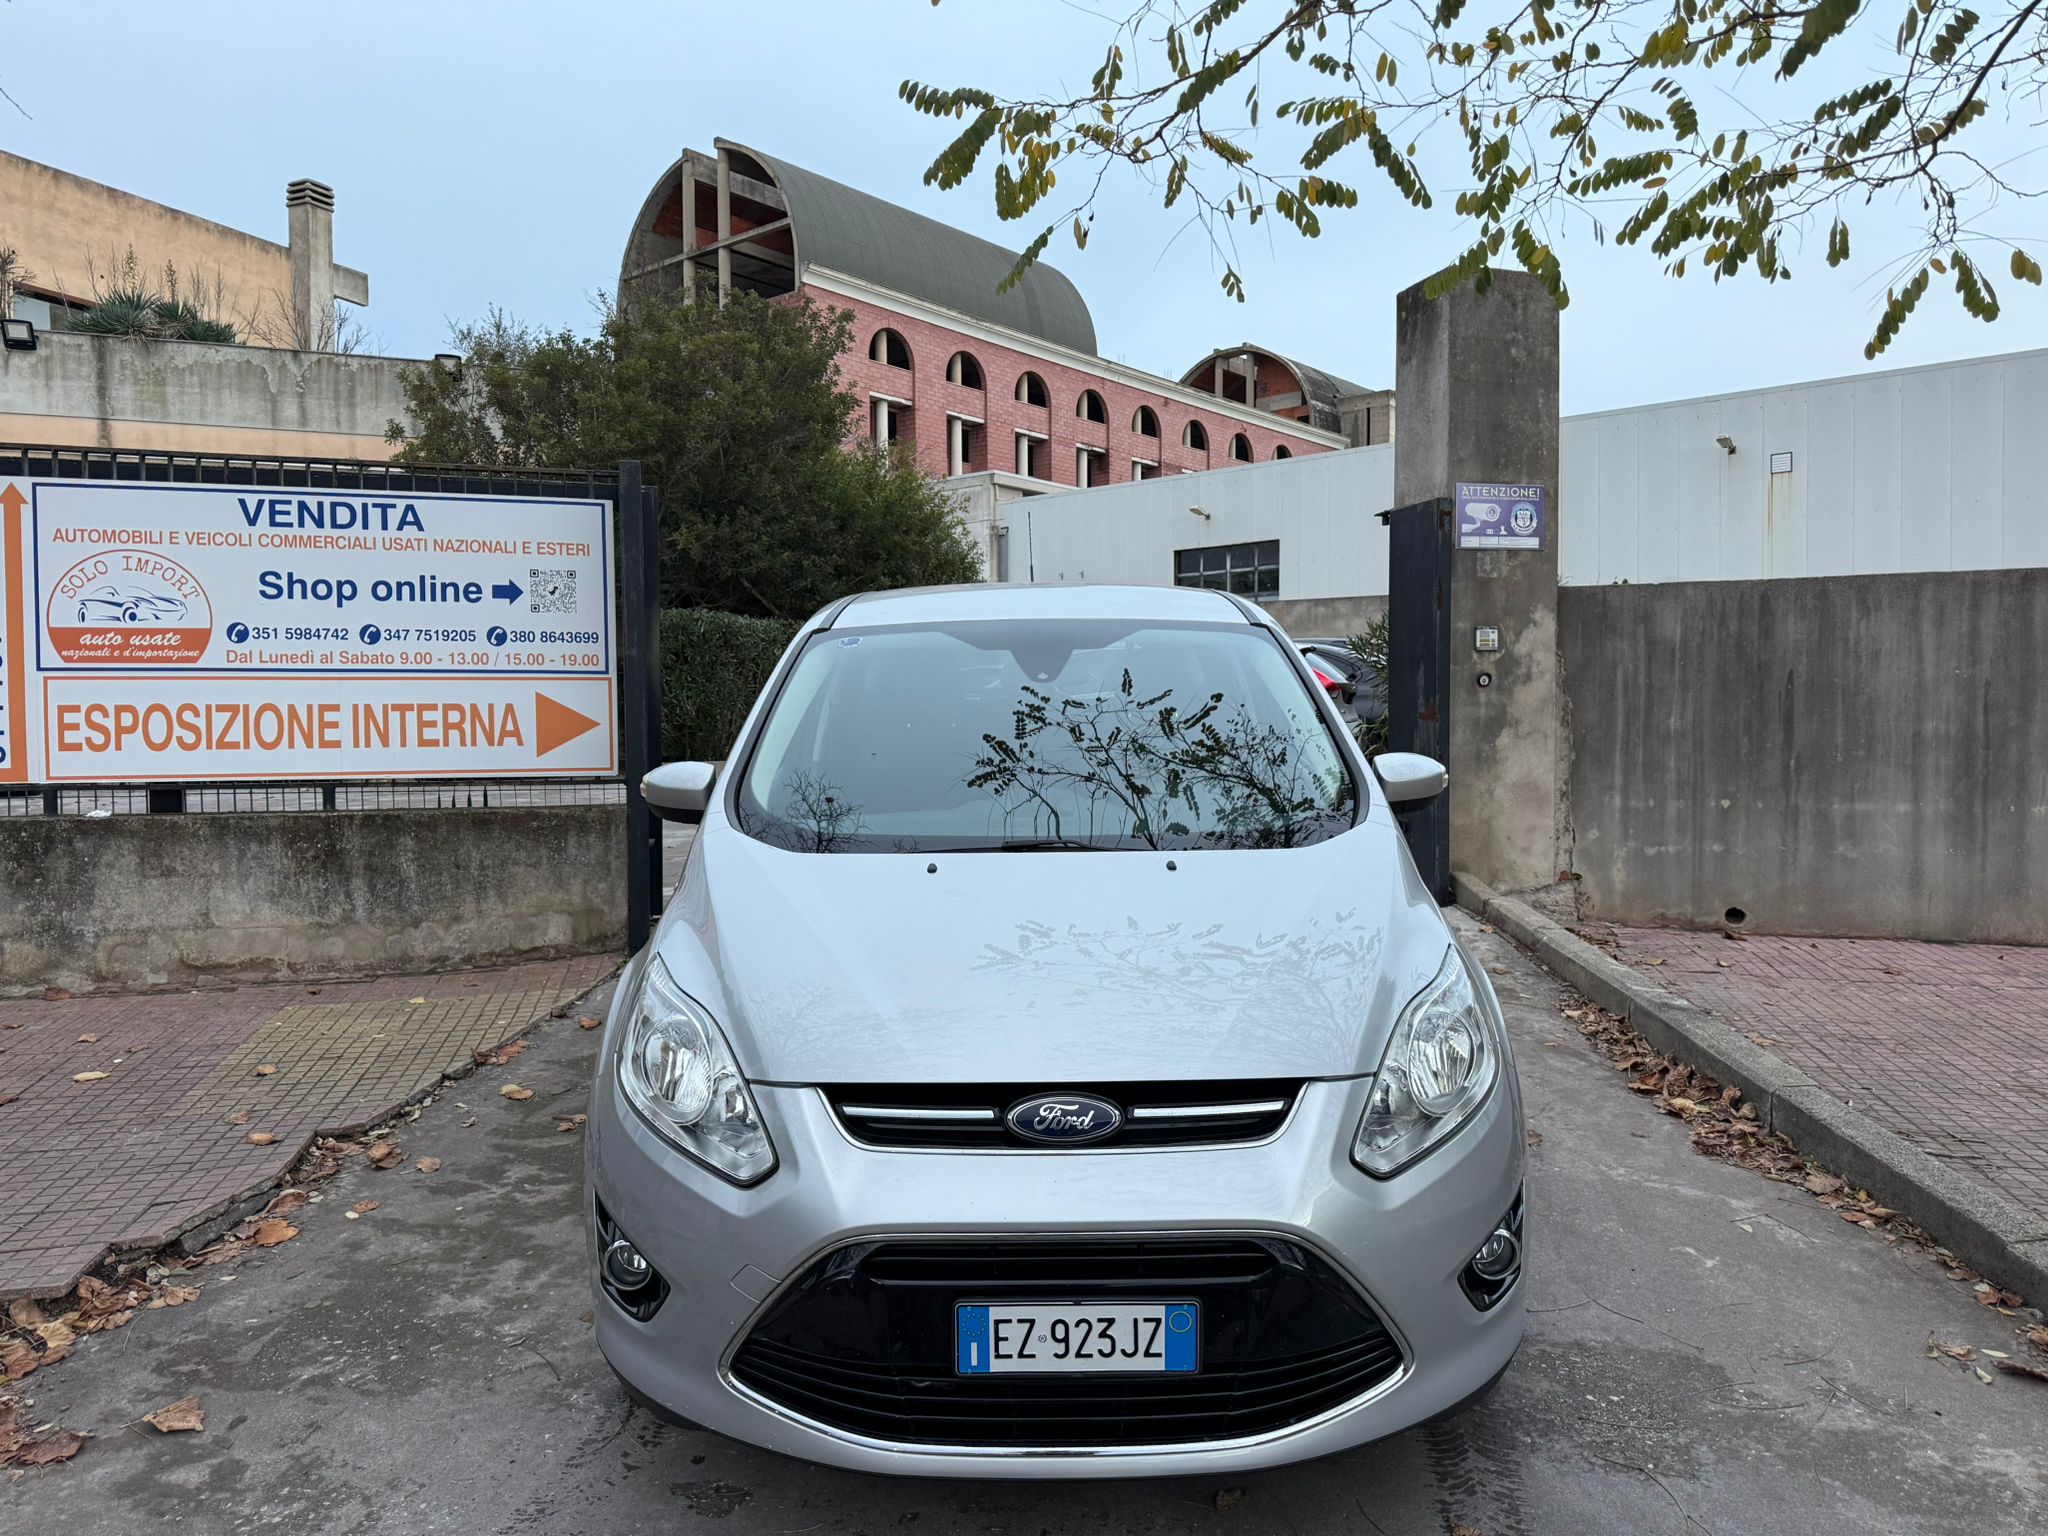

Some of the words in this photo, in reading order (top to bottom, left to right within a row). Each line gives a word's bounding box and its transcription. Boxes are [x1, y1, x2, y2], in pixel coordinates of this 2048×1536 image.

[1461, 486, 1540, 498] ATTENZIONE!
[237, 498, 425, 531] VENDITA
[53, 528, 163, 545] AUTOMOBILI
[169, 531, 180, 545] E
[185, 532, 252, 547] VEICOLI
[258, 533, 376, 550] COMMERCIALI
[382, 537, 428, 552] USATI
[433, 539, 517, 554] NAZIONALI
[522, 541, 532, 555] E
[537, 542, 590, 556] ESTERI
[60, 560, 109, 600] SOLO
[121, 555, 201, 600] IMPORT
[258, 570, 358, 608] Shop
[370, 575, 483, 603] online
[79, 631, 124, 646] auto
[129, 631, 182, 646] usate
[252, 627, 278, 640] 351
[285, 627, 349, 641] 5984742
[384, 628, 410, 641] 347
[415, 629, 476, 642] 7519205
[510, 630, 535, 643] 380
[540, 631, 599, 644] 8643699
[61, 648, 110, 660] nazionali
[123, 648, 200, 660] d'importazione
[226, 650, 252, 664] Dal
[259, 650, 314, 664] Lunedì
[320, 650, 333, 664] al
[339, 651, 395, 665] Sabato
[400, 652, 432, 665] 9.00
[449, 652, 489, 665] 13.00
[505, 653, 544, 666] 15.00
[560, 653, 600, 666] 19.00
[56, 702, 343, 753] ESPOSIZIONE
[352, 701, 525, 749] INTERNA
[1033, 1103, 1095, 1132] Ford
[994, 1318, 1037, 1359] EZ
[1050, 1317, 1163, 1359] 923JZ
